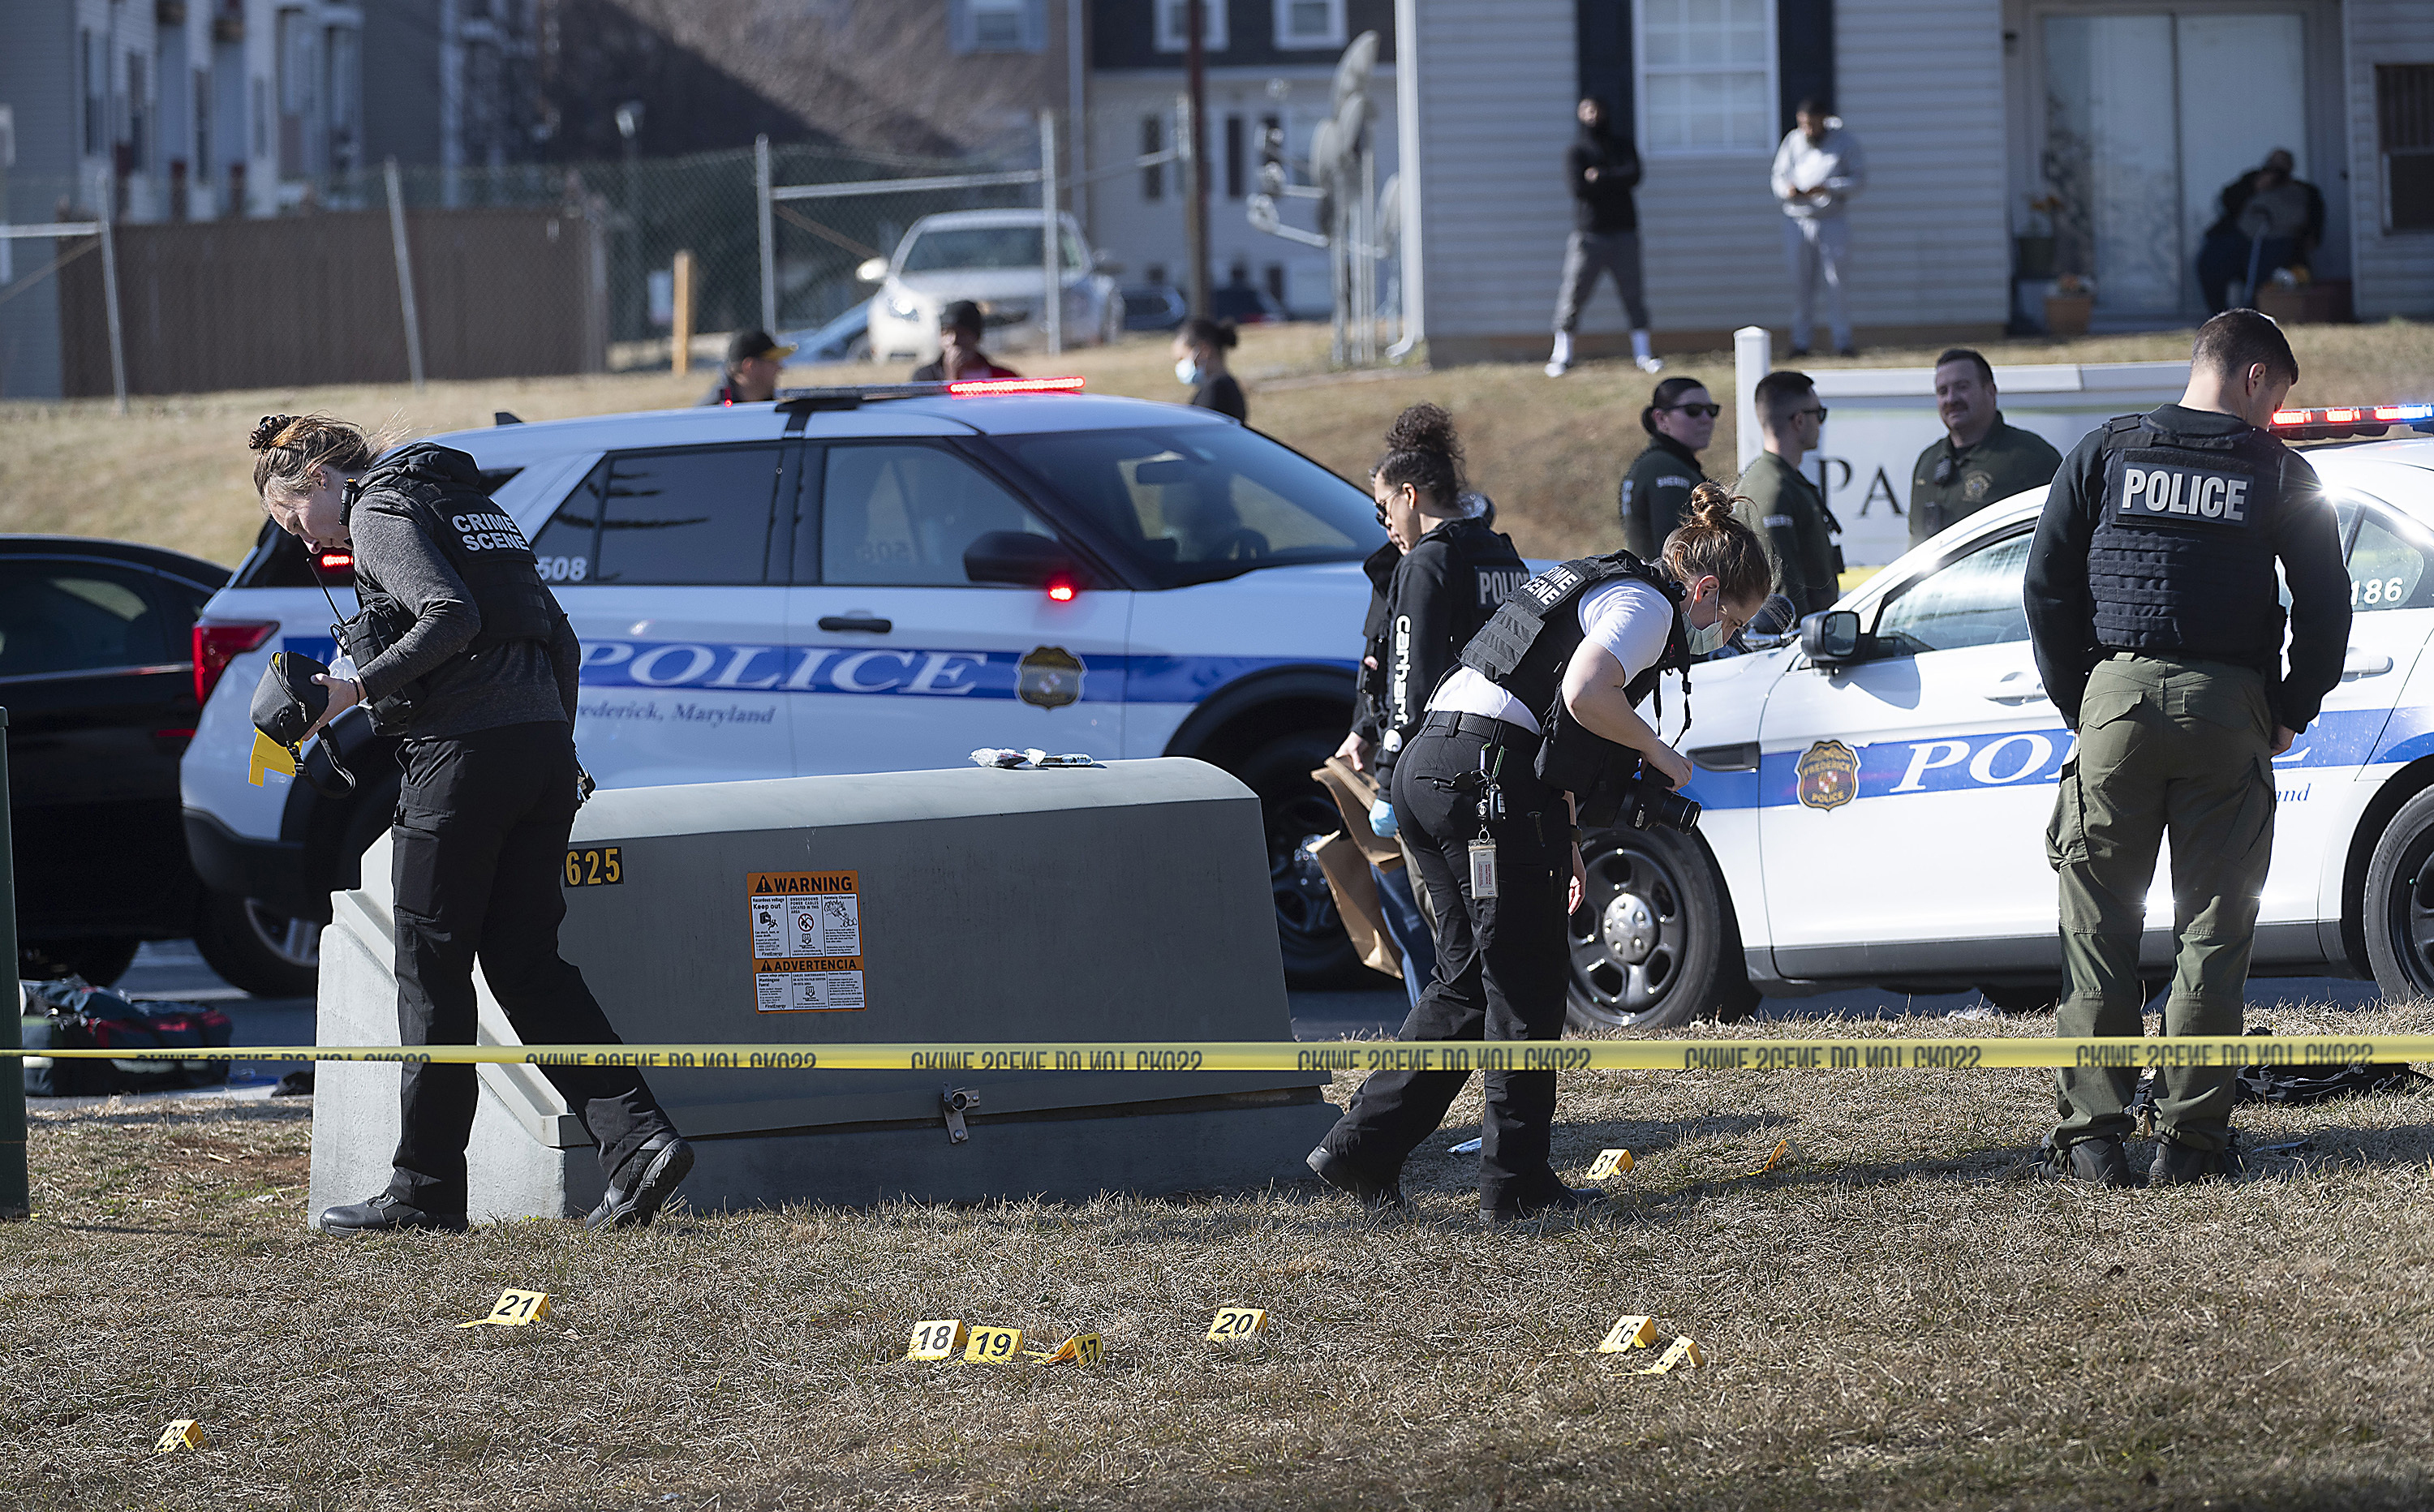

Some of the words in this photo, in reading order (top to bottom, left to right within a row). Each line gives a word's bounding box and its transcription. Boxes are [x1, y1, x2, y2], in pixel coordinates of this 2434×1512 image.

[2121, 468, 2248, 522] POLICE
[452, 513, 519, 534] CRIME
[462, 532, 531, 552] SCENE
[536, 555, 587, 582] 508
[1538, 565, 1580, 592] RIME
[1479, 571, 1529, 605] POLI
[2350, 577, 2404, 606] 186
[579, 642, 987, 695] POLICE
[578, 700, 664, 722] rederick,
[672, 702, 776, 728] Maryland
[1811, 790, 1844, 803] POLICE
[565, 848, 621, 885] 625
[773, 876, 853, 892] WARNING
[774, 959, 857, 972] ADVERTENCIA
[1591, 1155, 1619, 1175] 31
[496, 1295, 535, 1319] 21
[1214, 1312, 1254, 1335] 20
[1610, 1321, 1640, 1344] 16
[918, 1325, 952, 1351] 18
[975, 1331, 1012, 1357] 19
[1081, 1338, 1098, 1364] 17
[158, 1425, 185, 1450] 29
